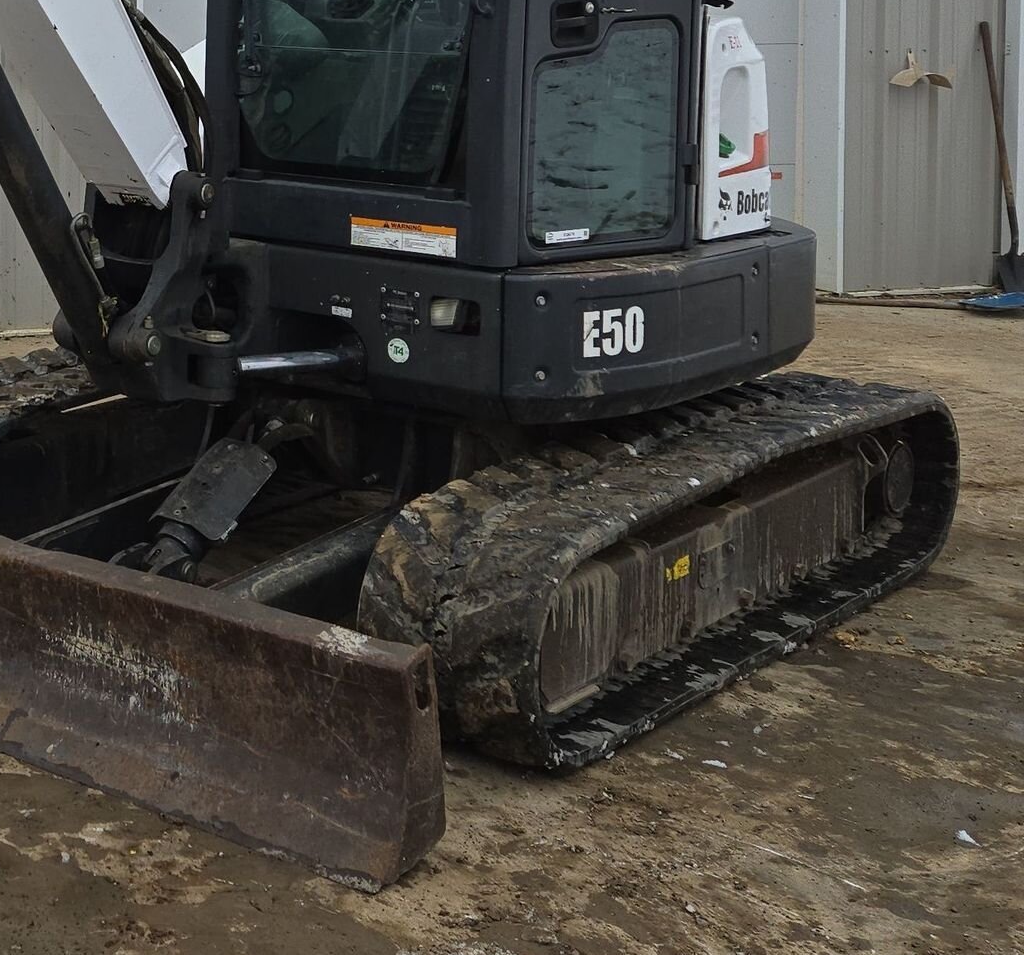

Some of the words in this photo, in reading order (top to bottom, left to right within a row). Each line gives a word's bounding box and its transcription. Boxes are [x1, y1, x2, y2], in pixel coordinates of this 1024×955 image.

[737, 188, 769, 216] Bobca
[391, 222, 422, 232] WARNING
[583, 306, 645, 358] E50
